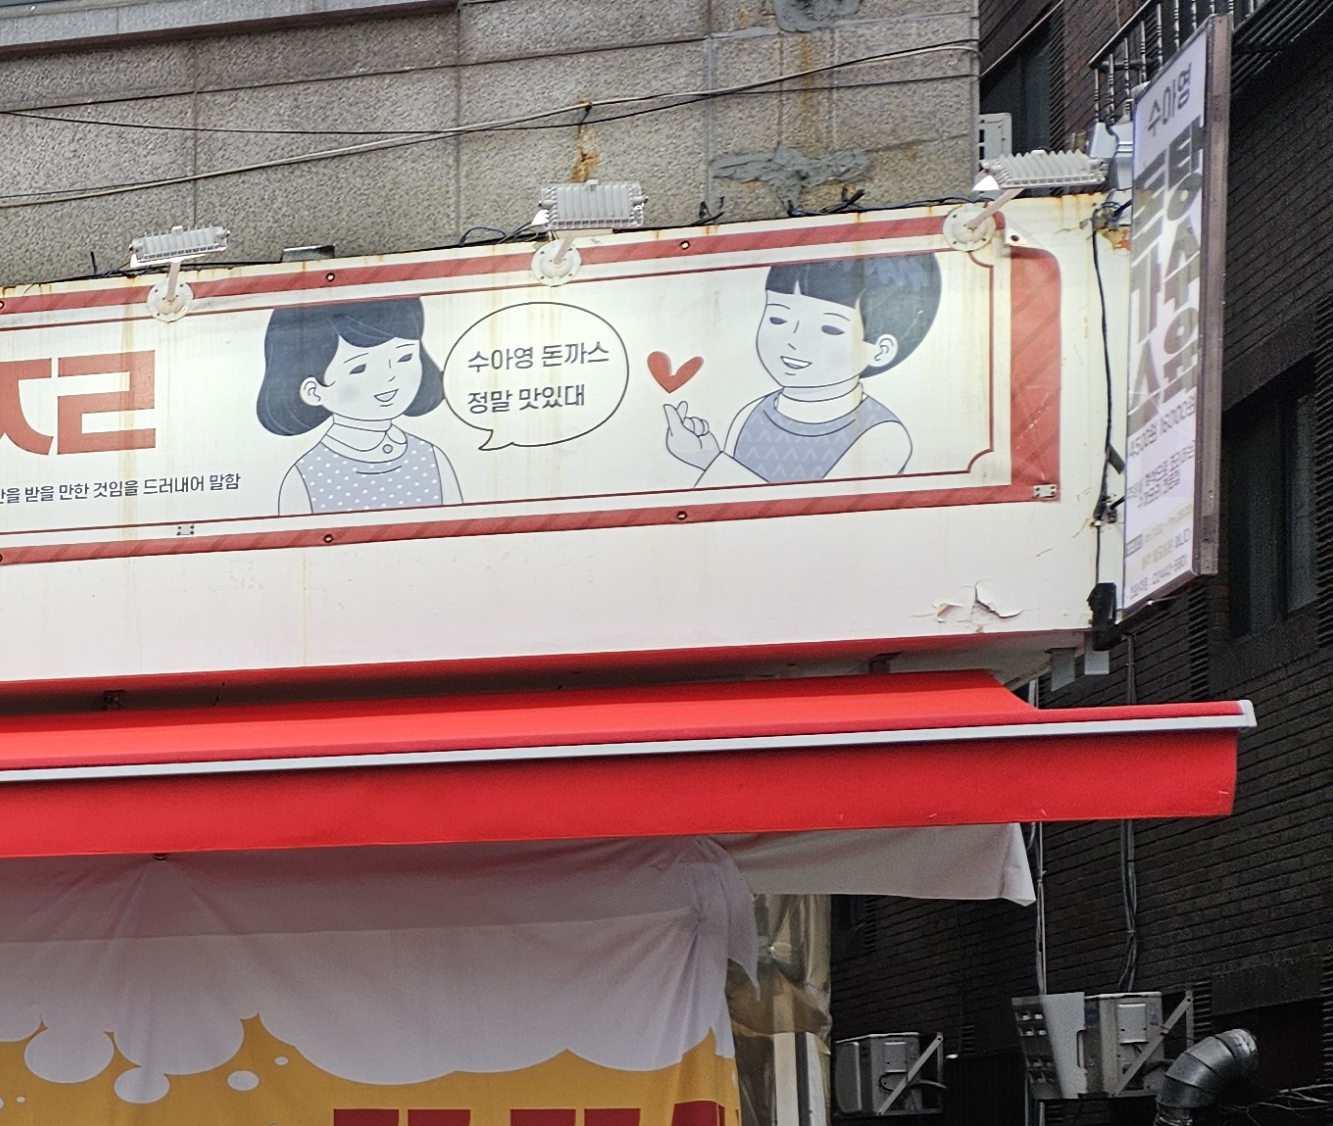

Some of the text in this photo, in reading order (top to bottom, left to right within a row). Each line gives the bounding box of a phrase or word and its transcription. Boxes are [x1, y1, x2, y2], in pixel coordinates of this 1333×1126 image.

[468, 341, 610, 373] 수아영 돈까스
[468, 384, 585, 414] 정말 맛있대
[24, 484, 55, 503] 받을
[58, 482, 90, 500] 만한
[93, 479, 139, 499] 것임을
[143, 475, 205, 496] 드러내어
[209, 473, 242, 492] 말함
